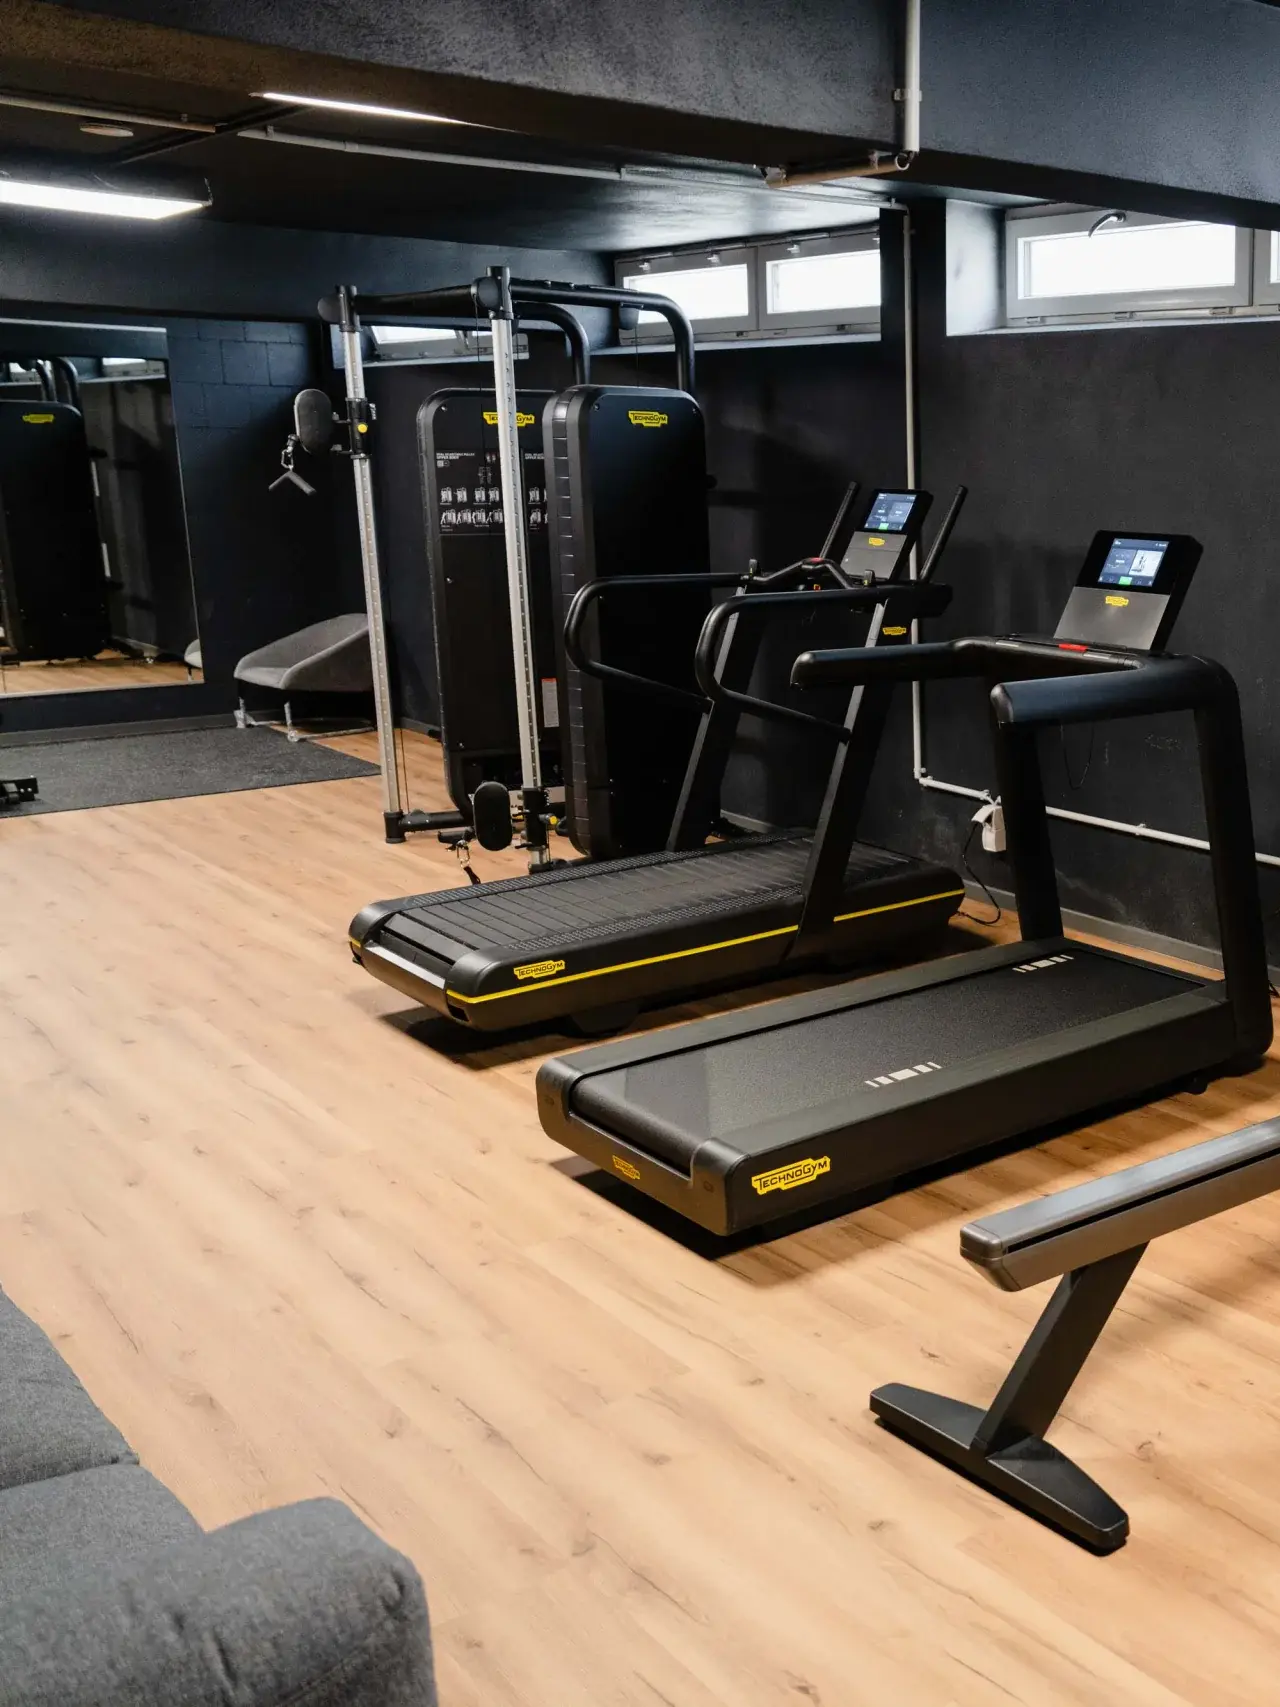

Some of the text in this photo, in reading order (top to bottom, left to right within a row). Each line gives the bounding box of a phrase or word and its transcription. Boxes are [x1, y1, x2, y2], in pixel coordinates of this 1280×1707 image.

[630, 412, 666, 424] TECHNOGYM
[514, 962, 564, 977] TECHNOGYM
[753, 1160, 828, 1191] TECHNOGYM
